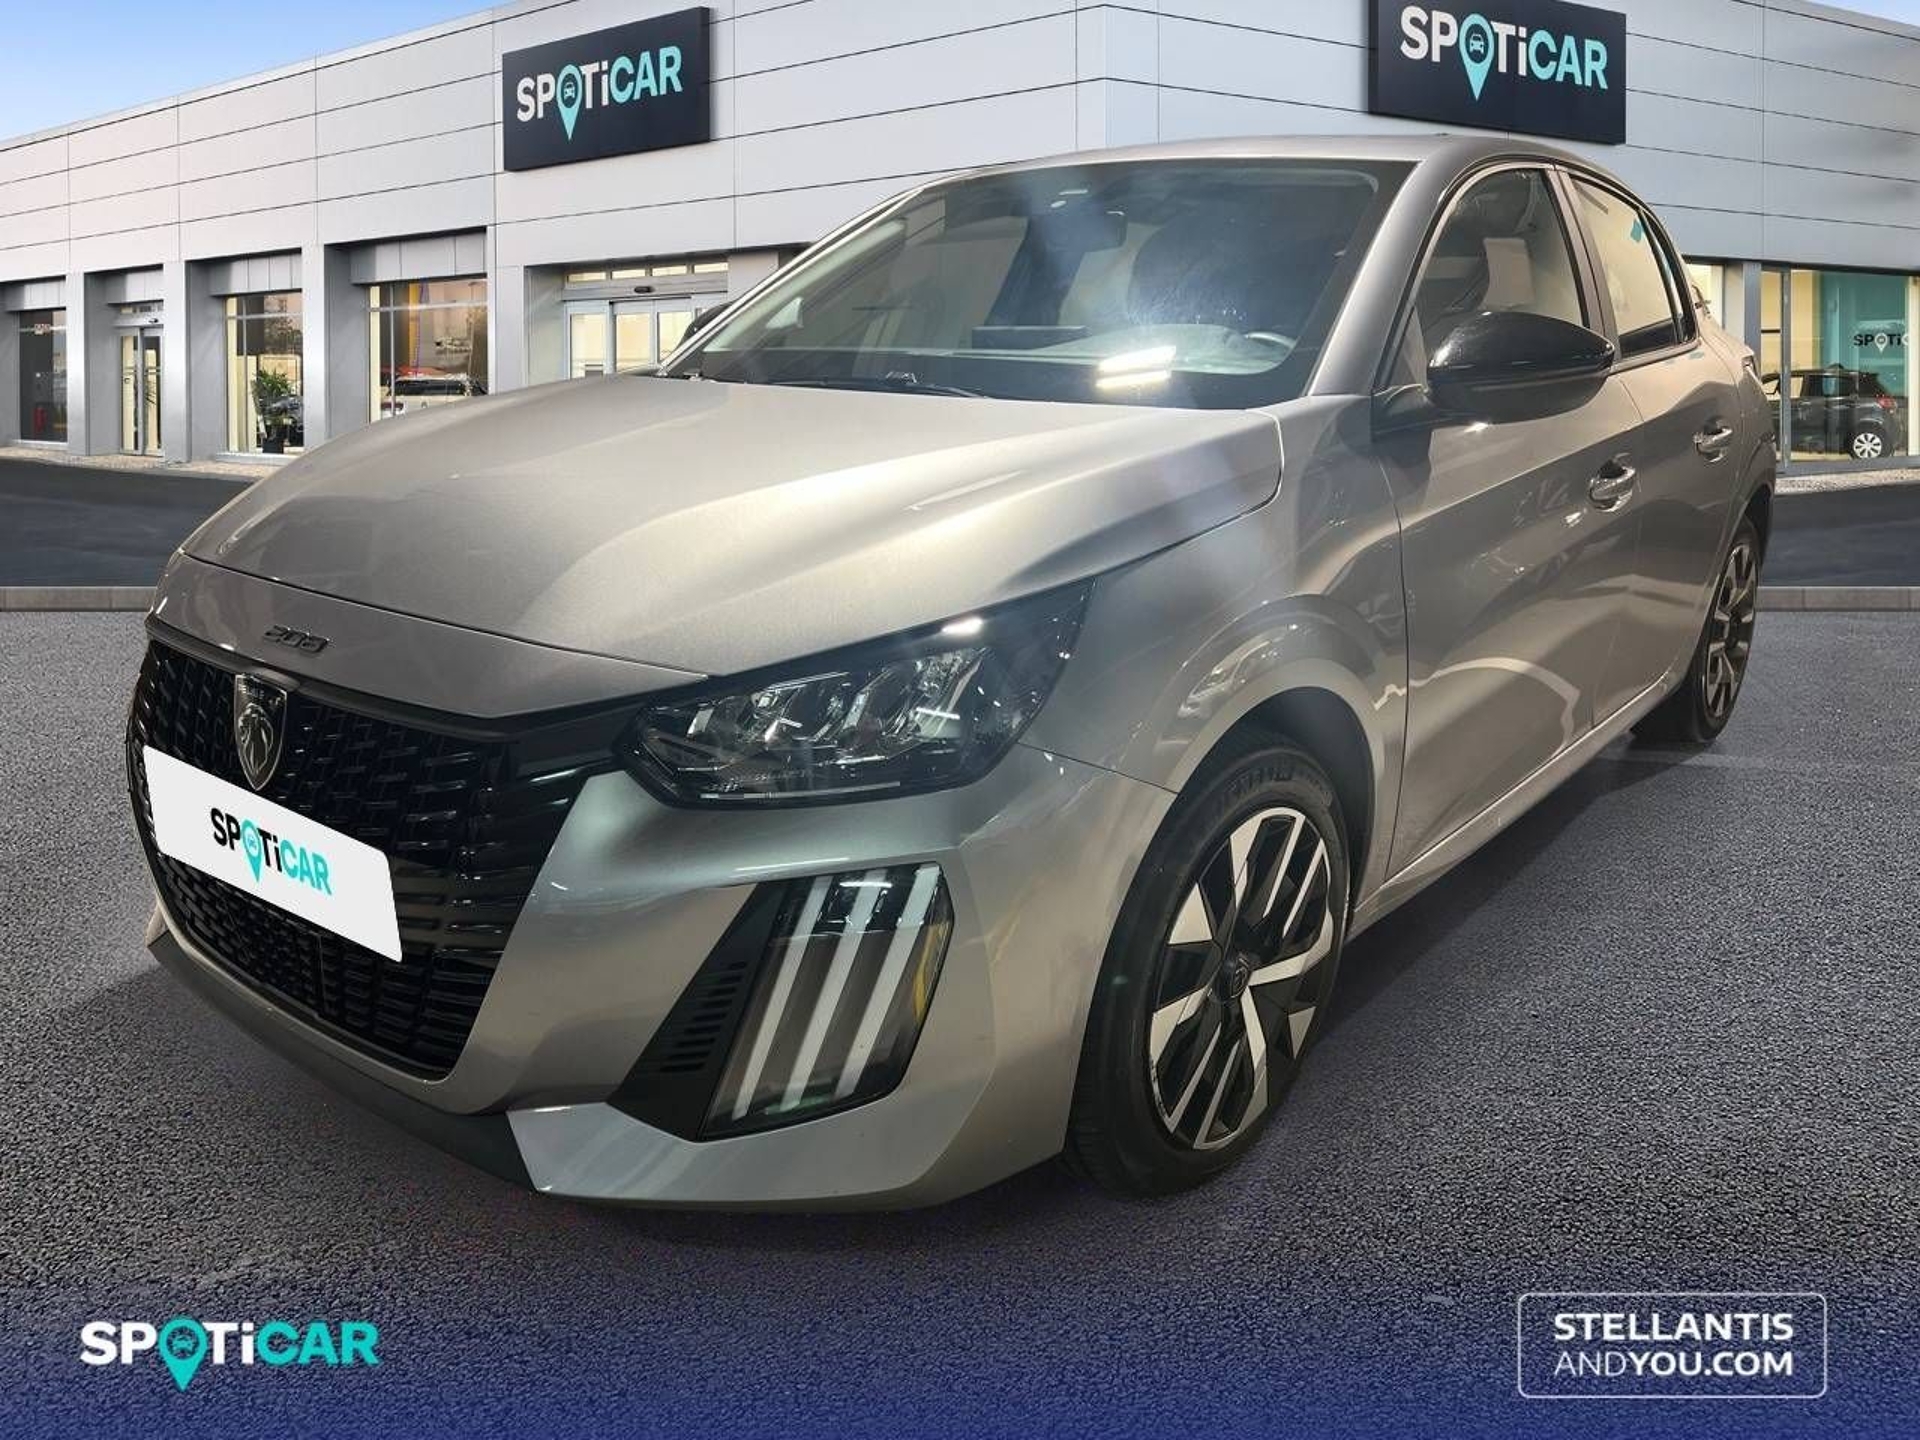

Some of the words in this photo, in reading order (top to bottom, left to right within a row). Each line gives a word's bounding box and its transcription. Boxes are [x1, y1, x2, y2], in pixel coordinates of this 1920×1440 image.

[516, 46, 683, 140] SPOTiCAR
[1400, 5, 1608, 101] SPOTiCAR
[210, 807, 332, 895] SPOTiCAR
